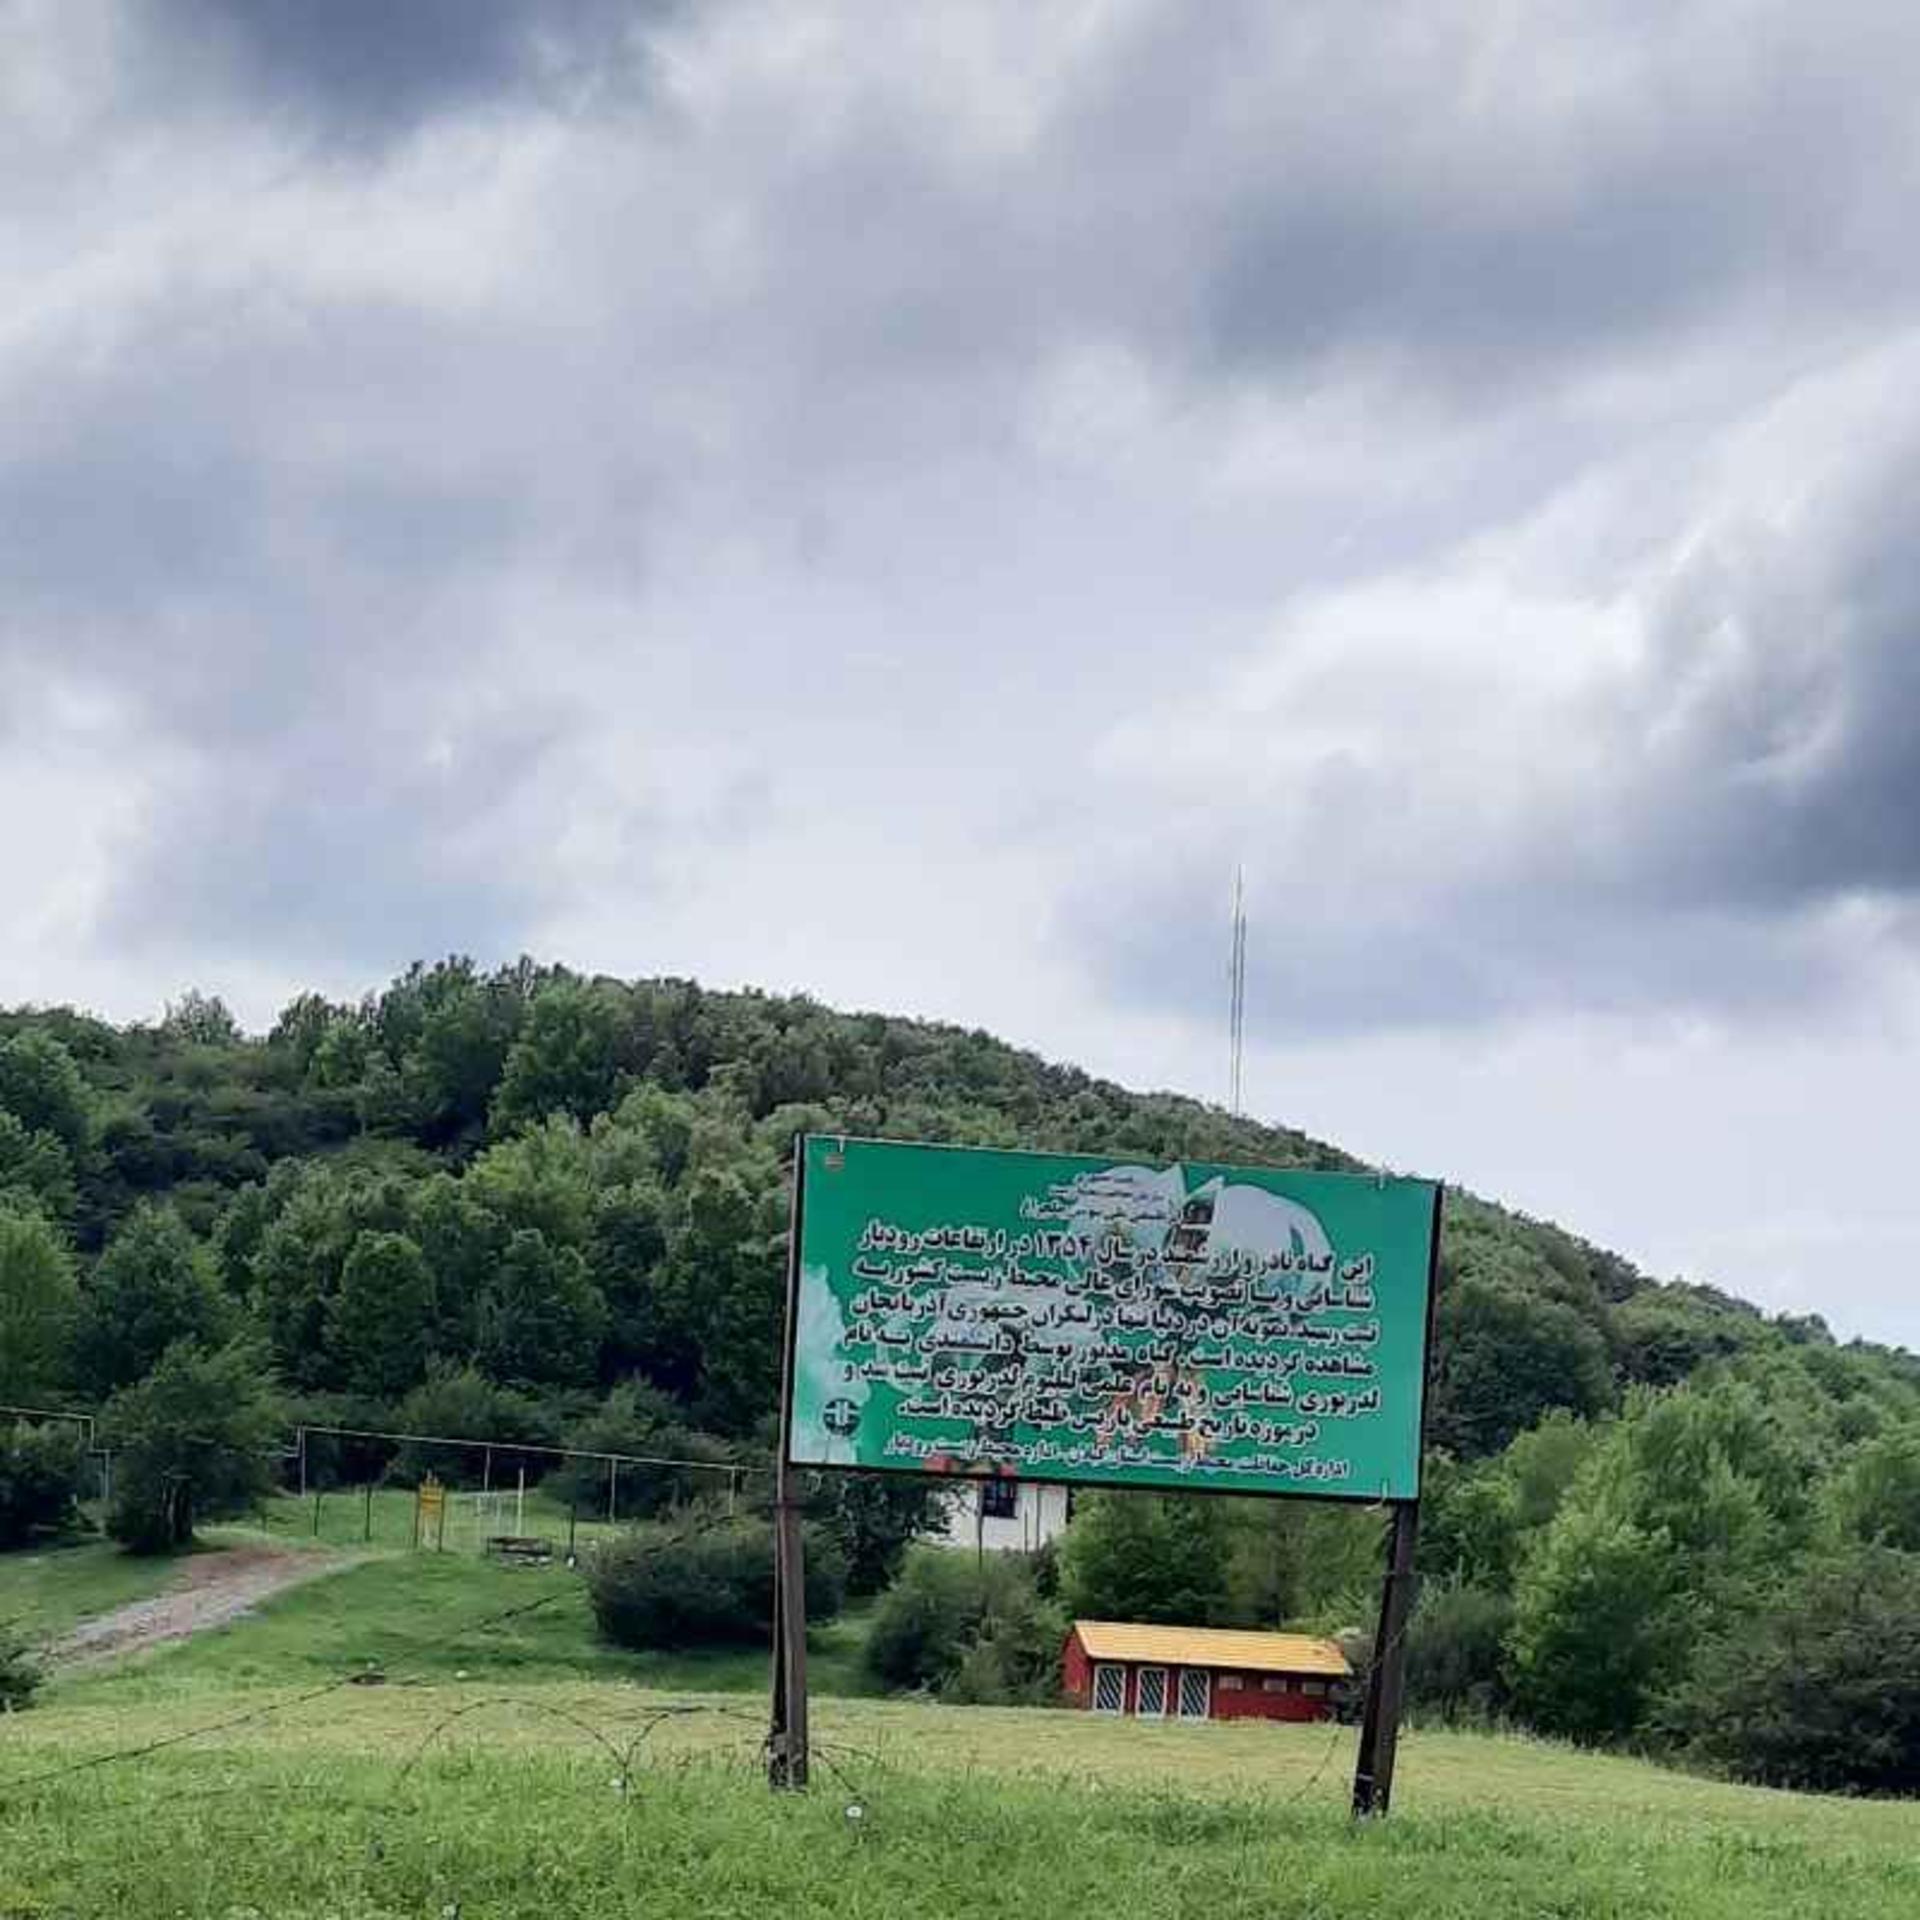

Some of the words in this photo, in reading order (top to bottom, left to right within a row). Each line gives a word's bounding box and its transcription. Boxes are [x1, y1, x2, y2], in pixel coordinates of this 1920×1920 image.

[860, 1220, 920, 1250] رودبار
[923, 1226, 1004, 1256] ارتفاعات
[1009, 1235, 1030, 1257] در
[1098, 1235, 1133, 1266] سال
[1136, 1248, 1158, 1266] در
[1259, 1249, 1292, 1274] نادر
[1297, 1251, 1333, 1272] گیاه
[948, 1266, 1002, 1290] زیست
[1009, 1264, 1060, 1288] محیط
[1341, 1256, 1372, 1280] این
[1065, 1270, 1111, 1296] عالی
[852, 1288, 946, 1320] آذربایجان
[1095, 1312, 1114, 1331] در
[1186, 1314, 1209, 1338] در
[1212, 1310, 1238, 1338] آن
[844, 1324, 873, 1346] نام
[1235, 1350, 1299, 1376] گردیده
[1081, 1373, 1133, 1398] علمی
[1139, 1375, 1167, 1397] نام
[1136, 1411, 1195, 1436] طبیعی
[1198, 1413, 1249, 1439] تاریخ
